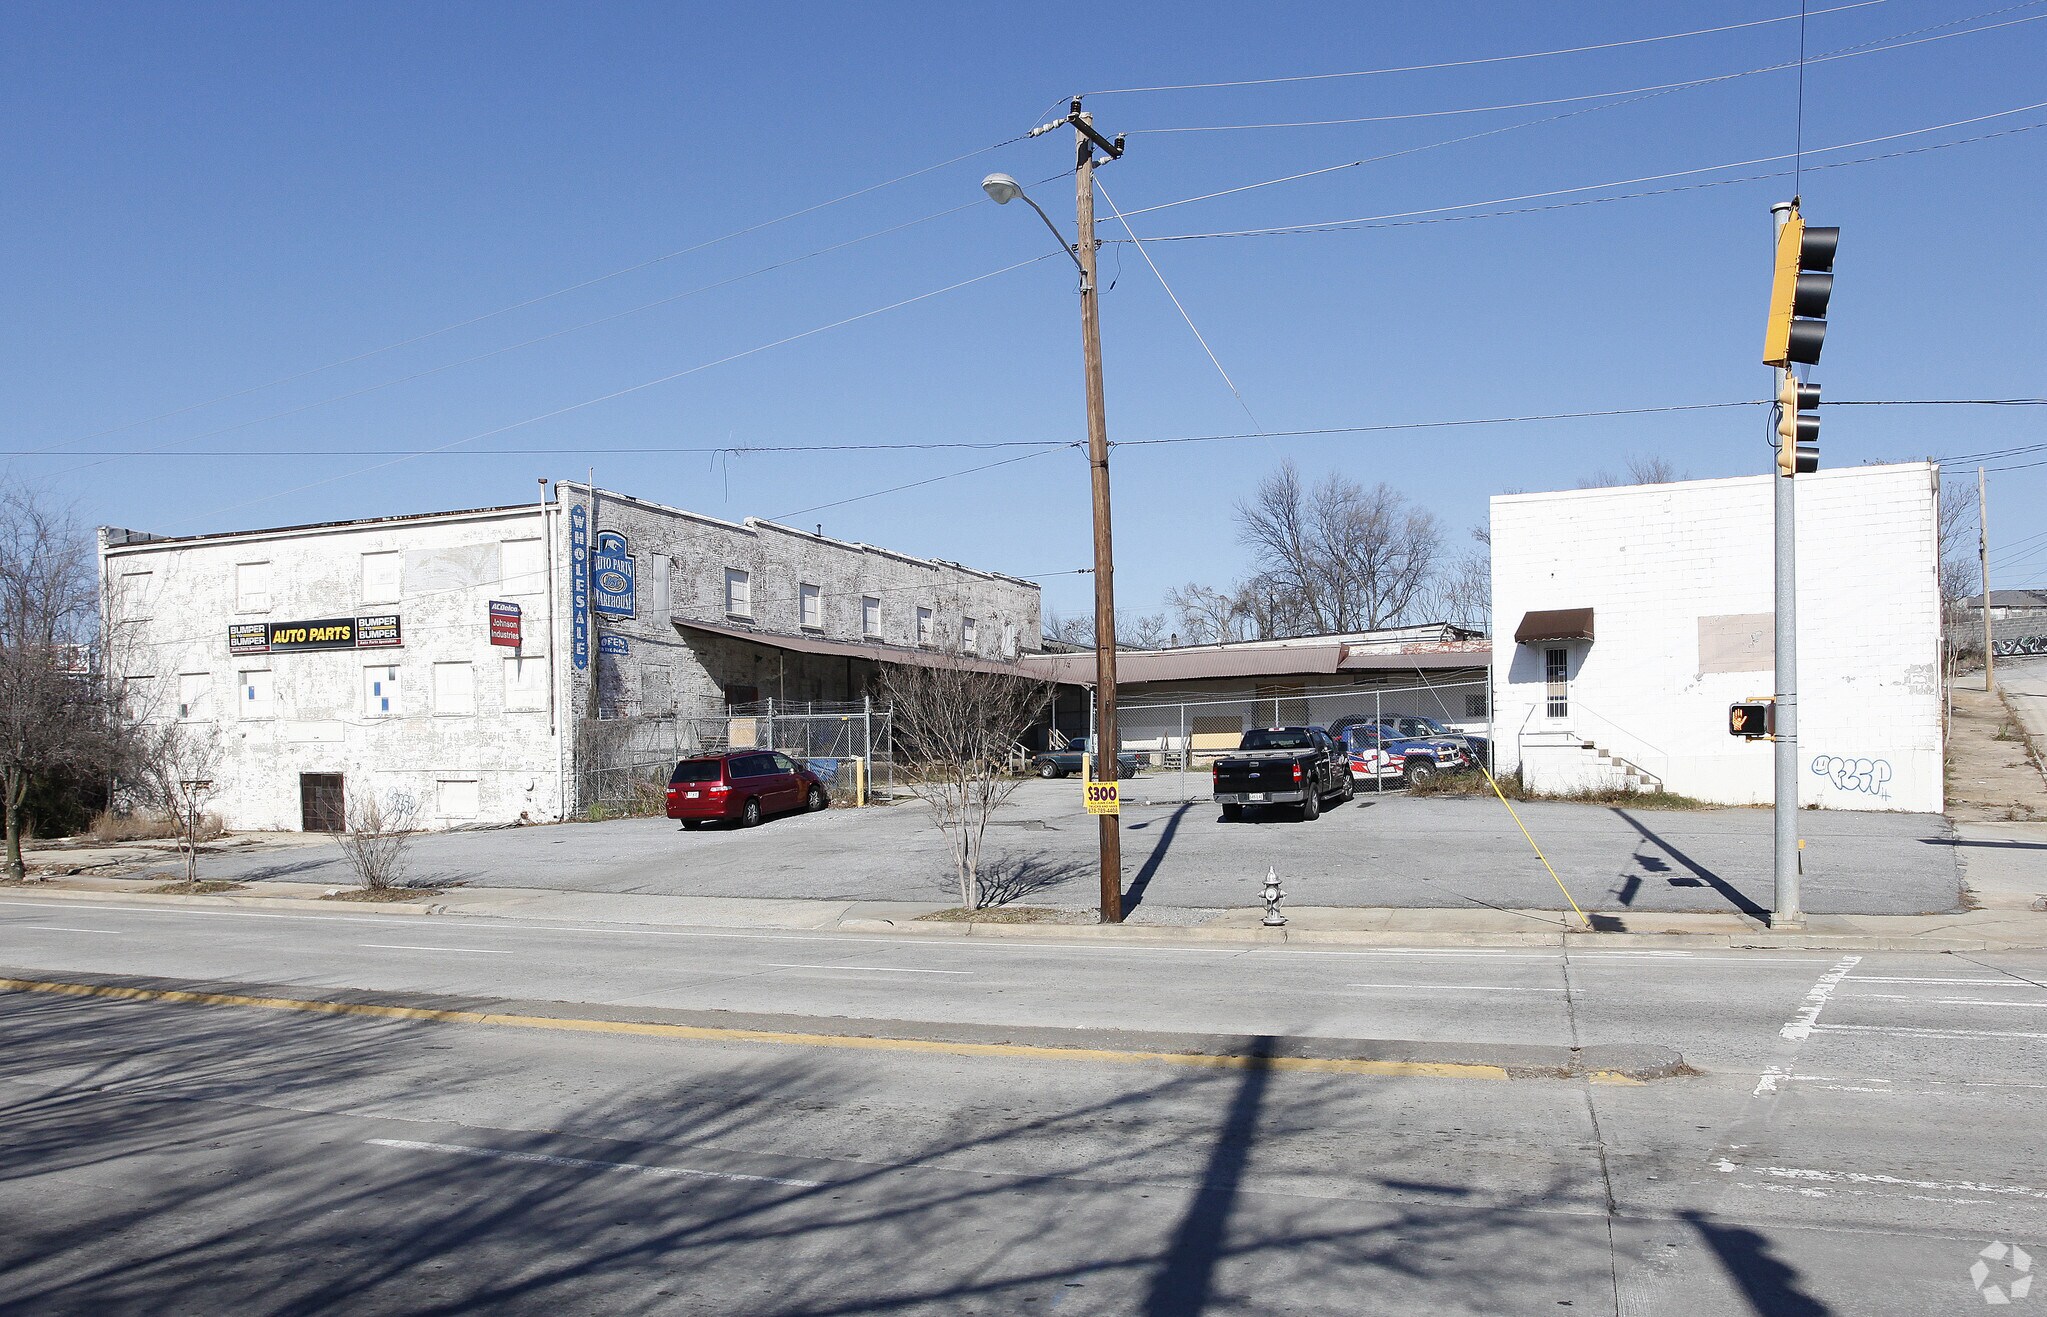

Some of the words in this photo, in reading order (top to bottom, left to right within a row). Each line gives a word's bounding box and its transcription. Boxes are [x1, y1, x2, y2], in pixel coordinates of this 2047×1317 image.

[594, 556, 611, 571] AUTO
[613, 559, 632, 577] PARTS
[573, 514, 585, 655] WHOLESALE
[593, 587, 631, 609] WAREHOUSE
[491, 603, 518, 612] ACDelco
[358, 616, 396, 626] BUMPER
[493, 618, 517, 628] Johnson
[229, 625, 265, 634] BUMPER
[272, 628, 306, 643] AUTO
[309, 626, 351, 642] PARTS
[359, 629, 397, 639] BUMPER
[491, 629, 519, 640] Industries
[230, 637, 266, 646] BUMPER
[1362, 748, 1397, 774] 2
[1088, 786, 1117, 801] $300
